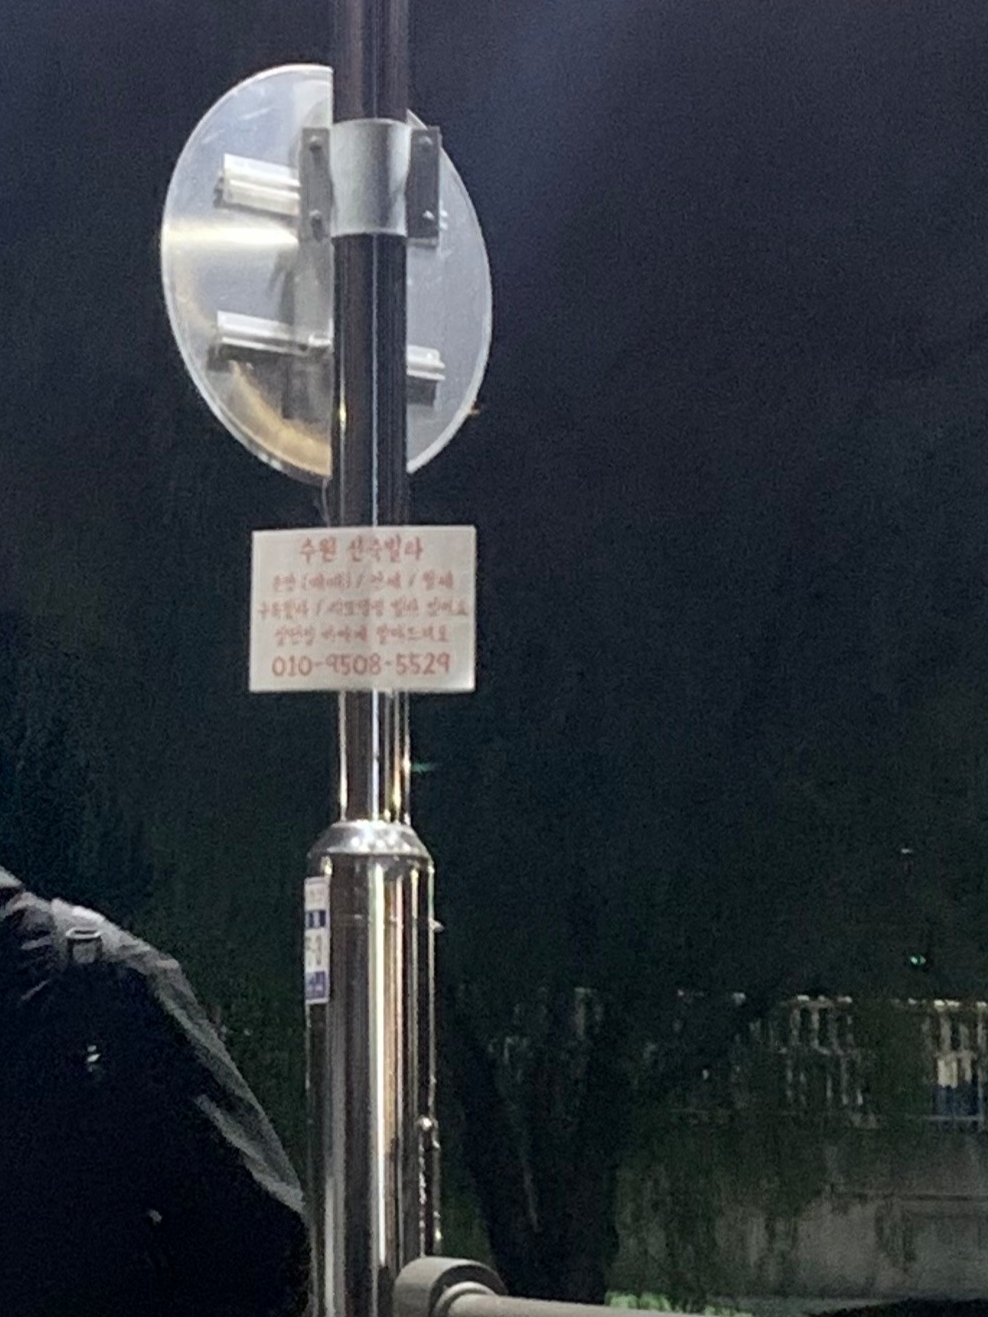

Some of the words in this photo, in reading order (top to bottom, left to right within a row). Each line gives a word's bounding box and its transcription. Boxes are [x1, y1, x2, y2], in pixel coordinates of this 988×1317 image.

[300, 536, 337, 563] 수원
[348, 534, 424, 563] 신축빌라
[271, 652, 451, 678] 010-9508-5529
